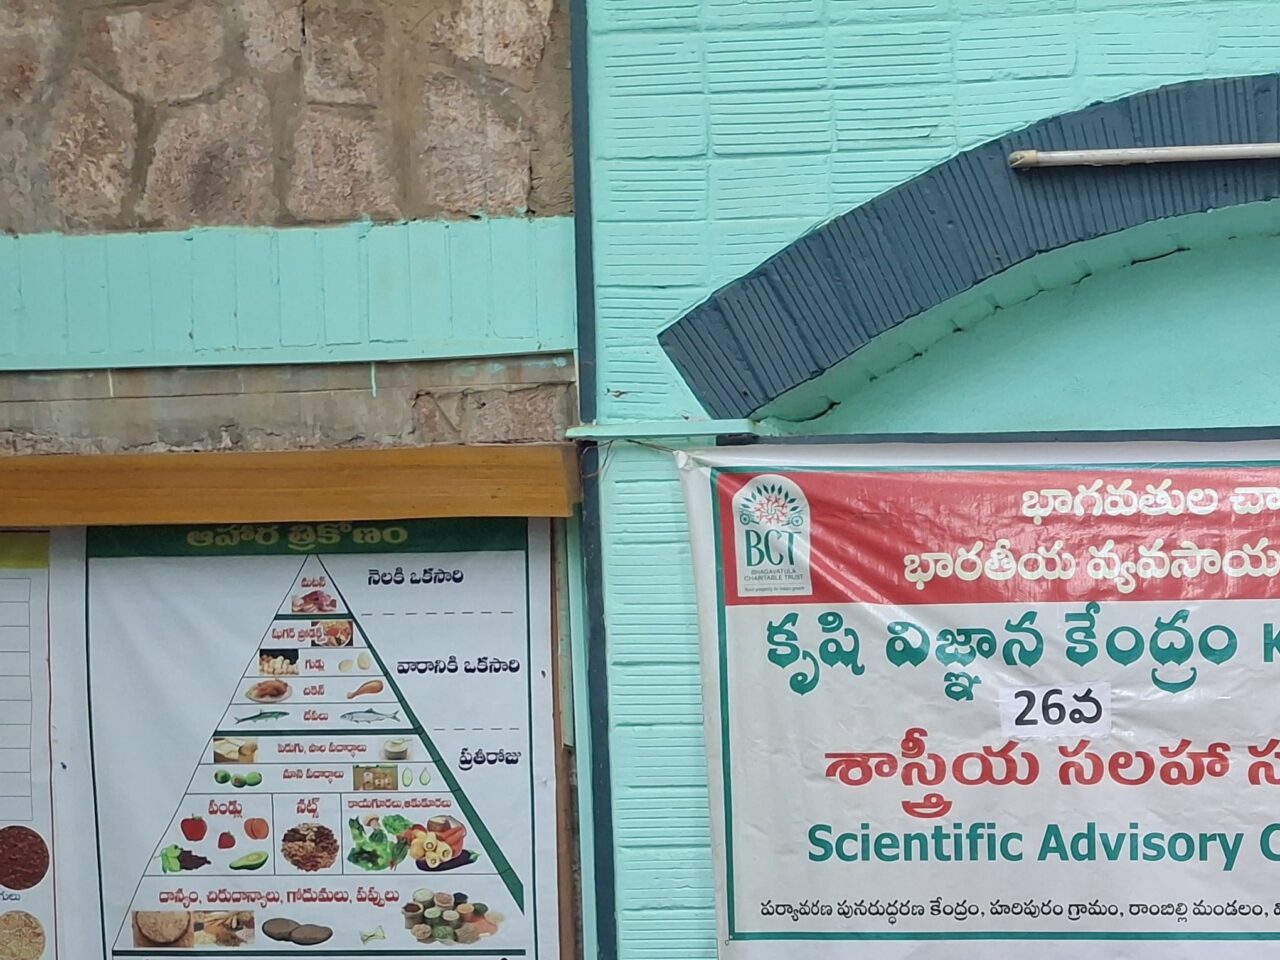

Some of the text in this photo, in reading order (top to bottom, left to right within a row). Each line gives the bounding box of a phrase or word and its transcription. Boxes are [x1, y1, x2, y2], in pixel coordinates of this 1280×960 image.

[1022, 479, 1218, 526] భాగవతుల
[745, 530, 801, 566] BCT
[903, 539, 1073, 590] భారతీయ
[1086, 537, 1280, 594] వ్యవసాయ
[368, 567, 465, 586] నెలకి ఒకసారి
[464, 656, 520, 675] ఒకసారి
[766, 601, 1238, 701] కృషి విజ్ఞాన కేంద్రం
[1014, 687, 1104, 727] 26వ
[824, 727, 1040, 819] శాస్త్రీయ
[1058, 738, 1231, 786] సలహా
[808, 822, 1024, 862] Scientific
[1037, 821, 1245, 871] Advisory
[760, 899, 834, 922] పర్యావరణ
[989, 899, 1064, 918] హరిపురం
[1129, 900, 1188, 923] రాంబిల్లి
